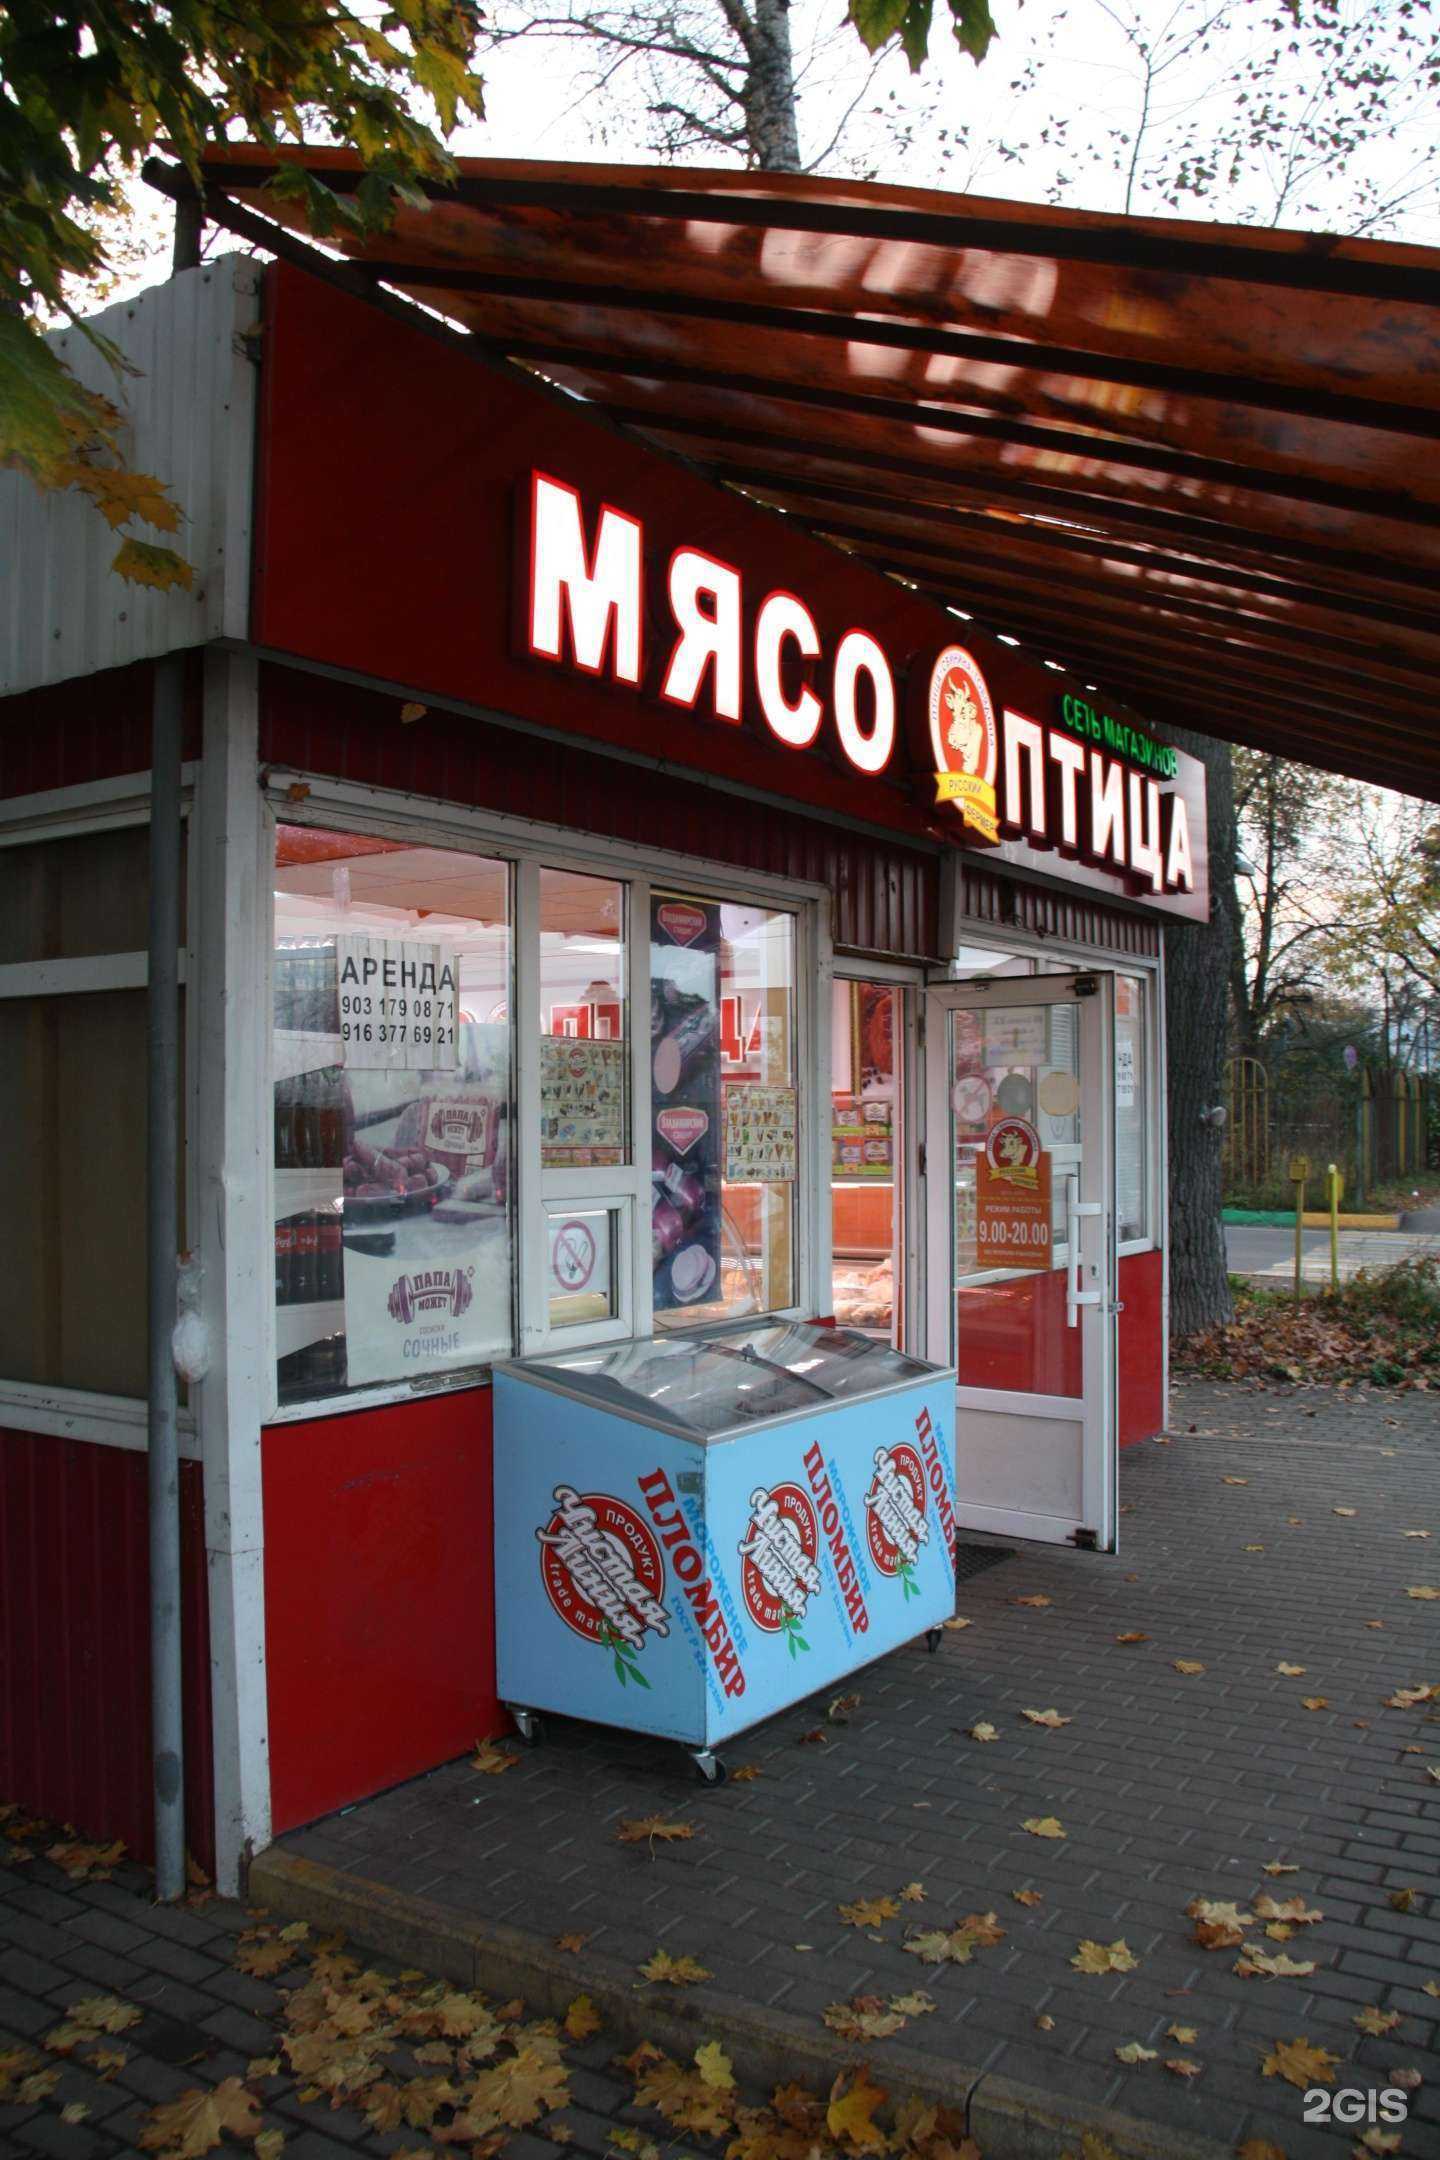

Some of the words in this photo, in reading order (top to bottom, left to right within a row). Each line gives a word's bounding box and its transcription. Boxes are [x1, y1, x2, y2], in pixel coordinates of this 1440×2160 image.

[529, 468, 896, 777] МЯСО
[1002, 707, 1194, 894] ПТИЦА
[1062, 693, 1101, 740] СЕТЬ
[1103, 714, 1179, 779] МАГАЗИНОВ
[341, 956, 455, 995] АРЕНДА
[342, 996, 372, 1015] 903
[379, 998, 407, 1016] 179
[414, 1000, 431, 1017] 08
[437, 1002, 453, 1019] 71
[342, 1023, 372, 1041] 916
[379, 1024, 407, 1042] 377
[414, 1026, 431, 1044] 69
[437, 1027, 454, 1044] 21
[979, 1220, 1048, 1245] 9.00-20.00
[412, 1270, 451, 1291] ПАПА
[417, 1296, 448, 1311] МОЖЕТ
[402, 1331, 461, 1359] СОЧНЫЕ
[605, 1509, 656, 1581] ПРОДУКТ
[783, 1495, 814, 1547] ПРОДУКТ
[803, 1440, 869, 1635] ПЛОМБИР
[552, 1484, 672, 1638] Чистая
[637, 1467, 746, 1698] ПЛОМБИР
[683, 1497, 748, 1655] МОРОЖЕНОЕ
[550, 1563, 572, 1608] trade
[575, 1610, 610, 1633] mark
